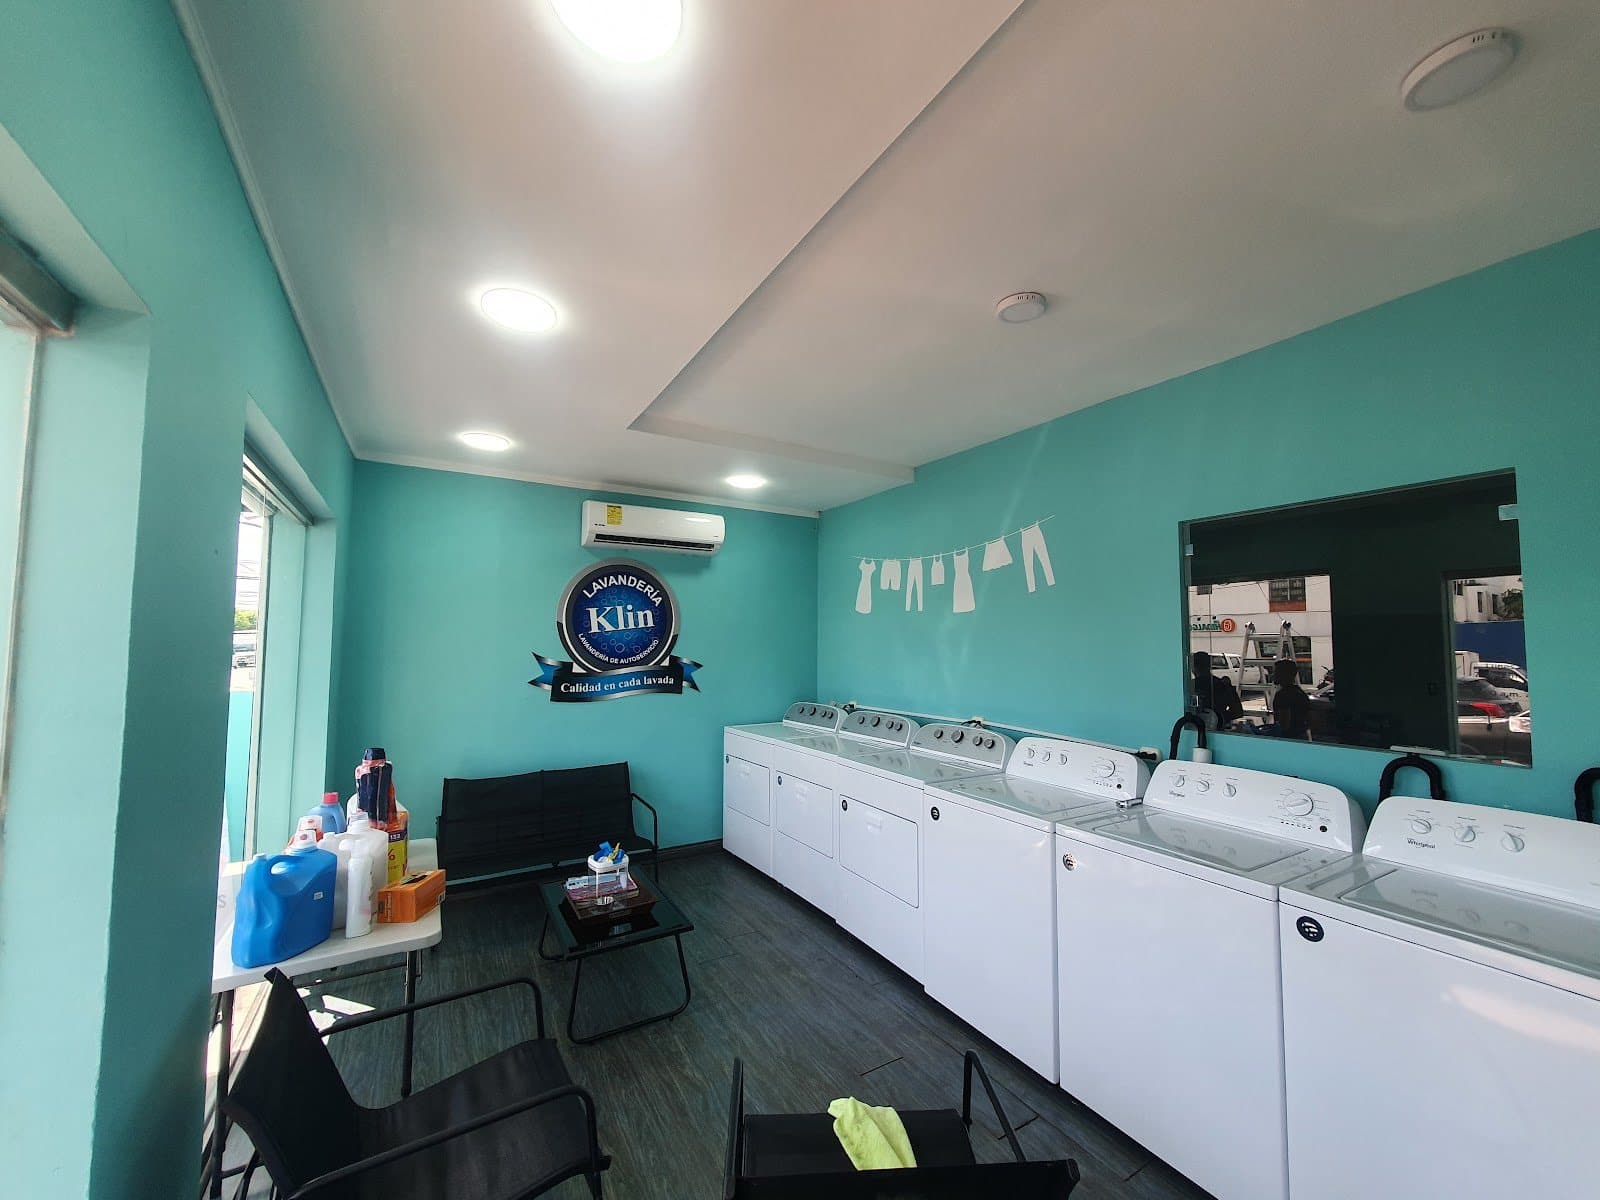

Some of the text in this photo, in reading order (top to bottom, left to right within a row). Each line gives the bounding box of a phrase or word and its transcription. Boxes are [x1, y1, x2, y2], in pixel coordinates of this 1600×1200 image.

[583, 574, 662, 607] LAVANDERÍA
[586, 604, 655, 633] Klin
[619, 639, 659, 664] AUTOSERVICIO
[560, 675, 674, 693] Calidad en cada lavada
[1407, 837, 1436, 849] Whirlpool
